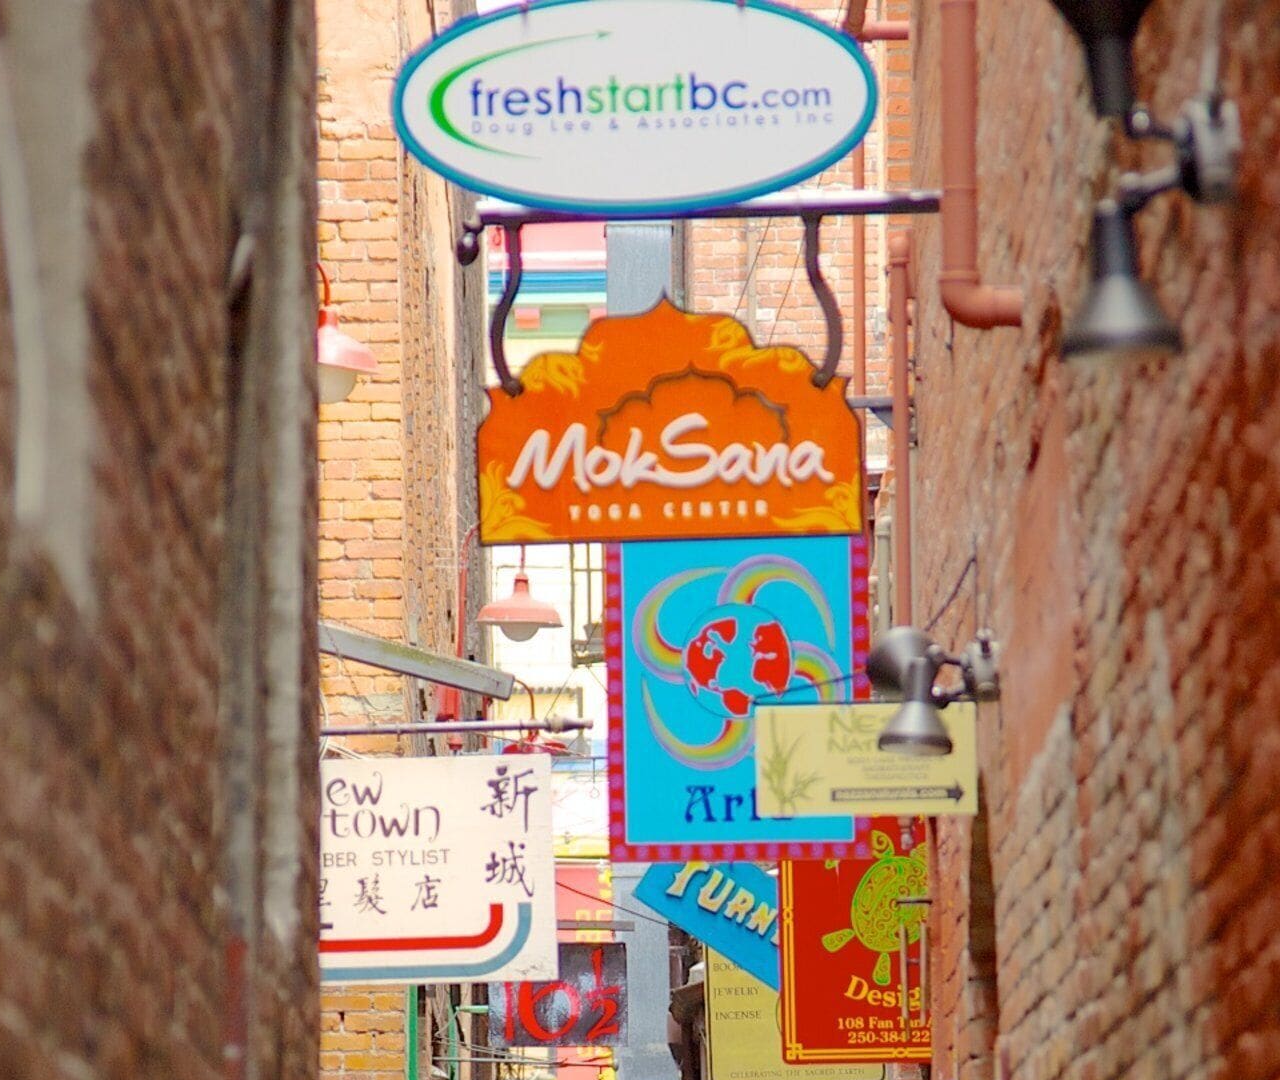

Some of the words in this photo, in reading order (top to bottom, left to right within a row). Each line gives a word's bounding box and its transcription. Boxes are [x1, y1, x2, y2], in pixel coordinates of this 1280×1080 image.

[470, 73, 831, 116] freshstartbc.com
[471, 120, 533, 136] Doug
[550, 118, 591, 131] Lee
[608, 117, 619, 130] &
[637, 113, 779, 129] Associates
[796, 111, 832, 124] Inc
[507, 412, 835, 493] MokSana
[570, 503, 642, 521] YOGA
[663, 500, 769, 519] CENTER
[326, 771, 383, 806] ew
[684, 785, 793, 823] Ar
[323, 803, 440, 843] town
[480, 765, 538, 898] 新城
[322, 852, 357, 868] BER
[372, 849, 450, 866] STYLIST
[666, 860, 779, 946] TURN
[713, 986, 760, 1000] JEWELRY
[844, 975, 922, 1011] Desig
[715, 1010, 761, 1021] INCENSE
[838, 1016, 864, 1030] 108
[869, 1016, 894, 1029] Fan
[730, 1069, 782, 1079] CELEBRATING
[786, 1069, 801, 1078] THE
[805, 1067, 835, 1077] SACRED
